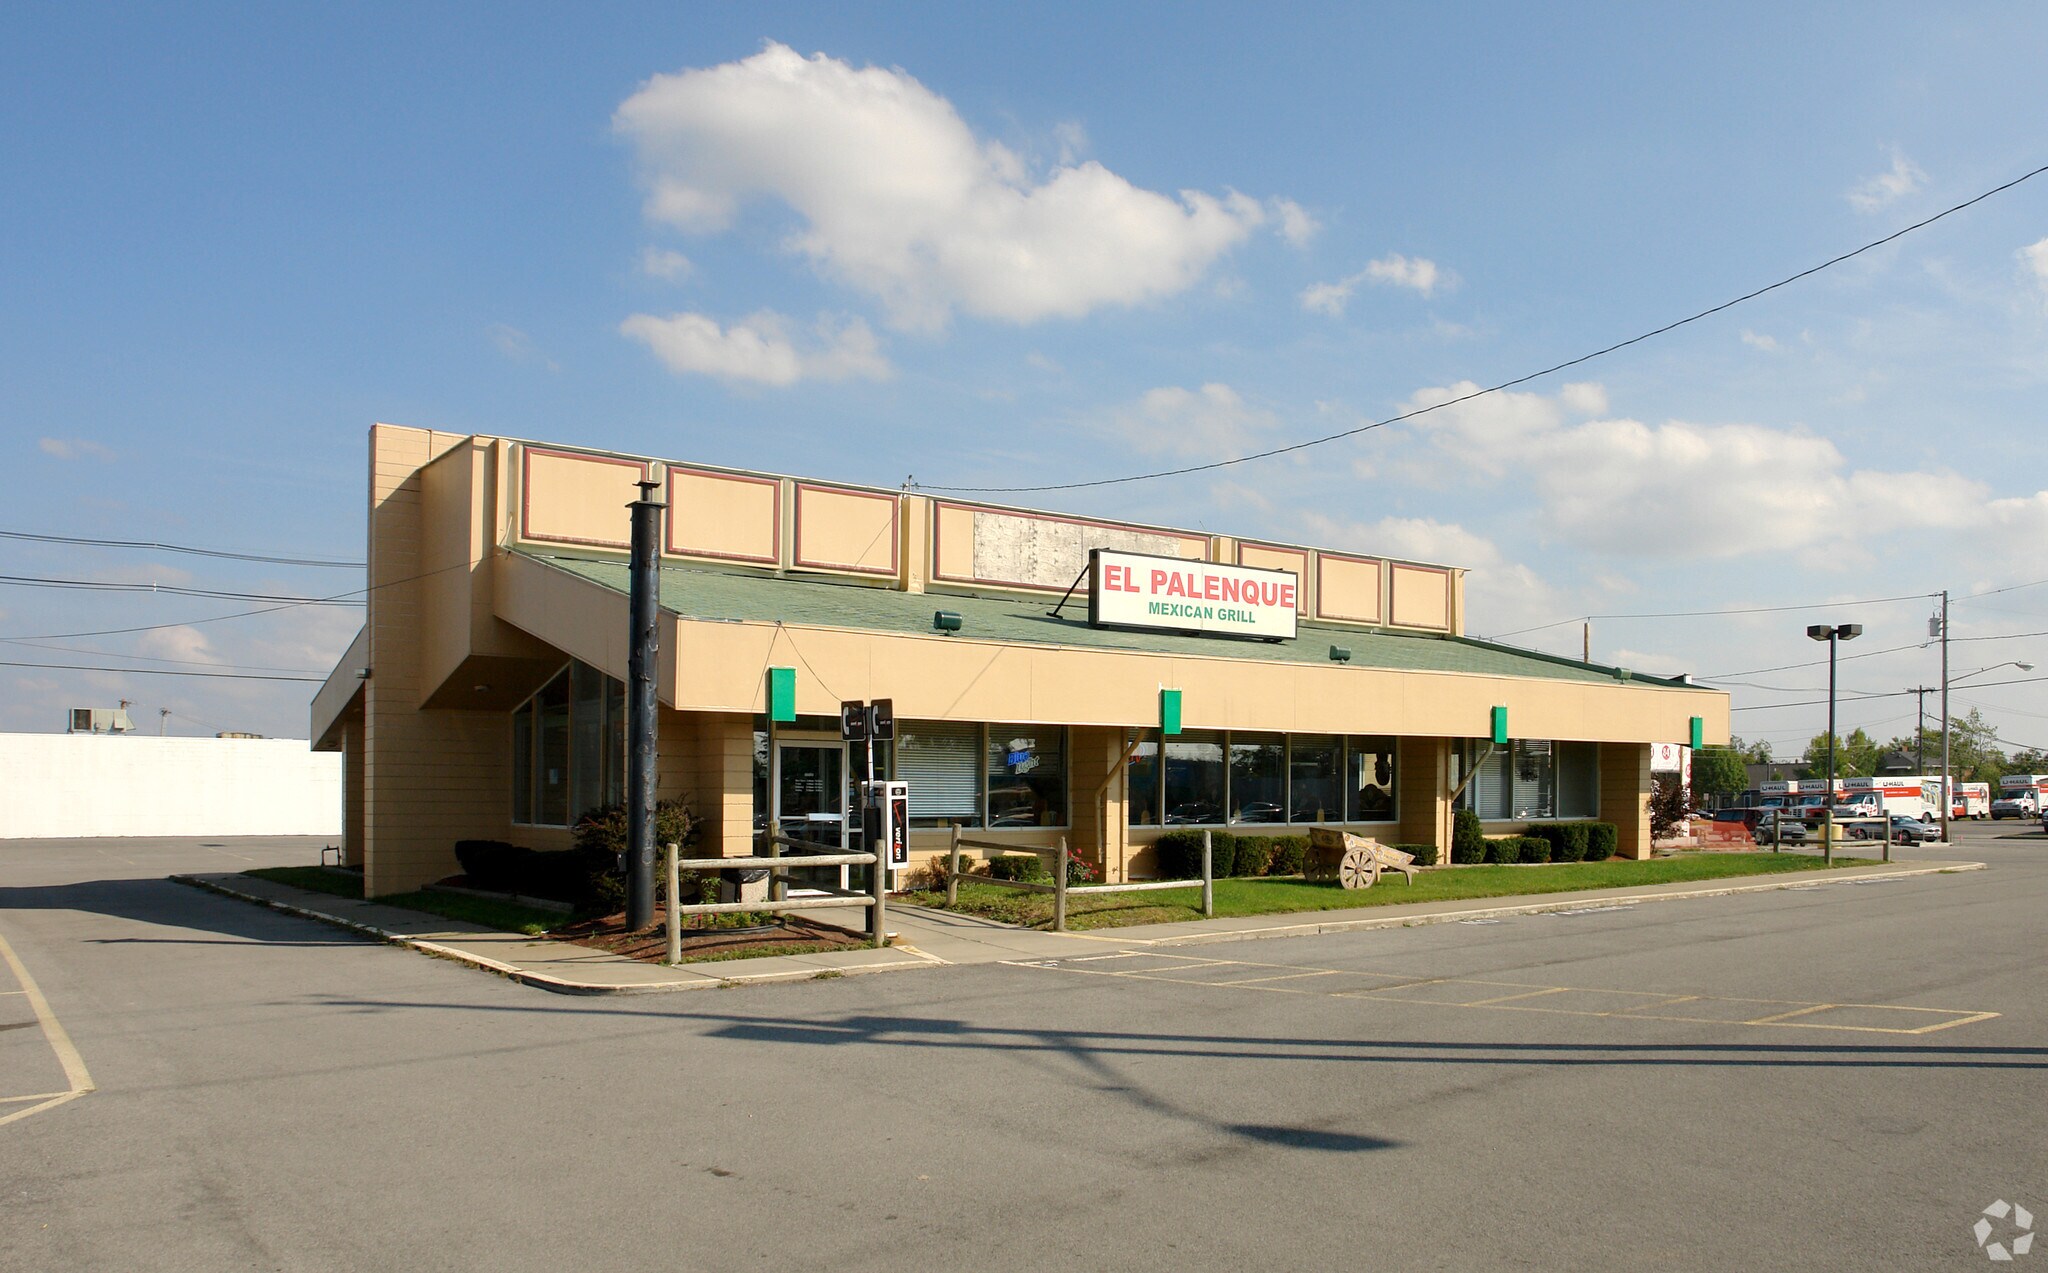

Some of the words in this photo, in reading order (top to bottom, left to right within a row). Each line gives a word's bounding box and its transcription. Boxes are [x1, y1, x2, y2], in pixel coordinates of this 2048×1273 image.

[1104, 564, 1140, 593] EL
[1151, 569, 1295, 609] PALENQUE
[1148, 601, 1213, 619] MEXICAN
[1217, 608, 1256, 624] GRILL
[895, 826, 903, 860] verizon
